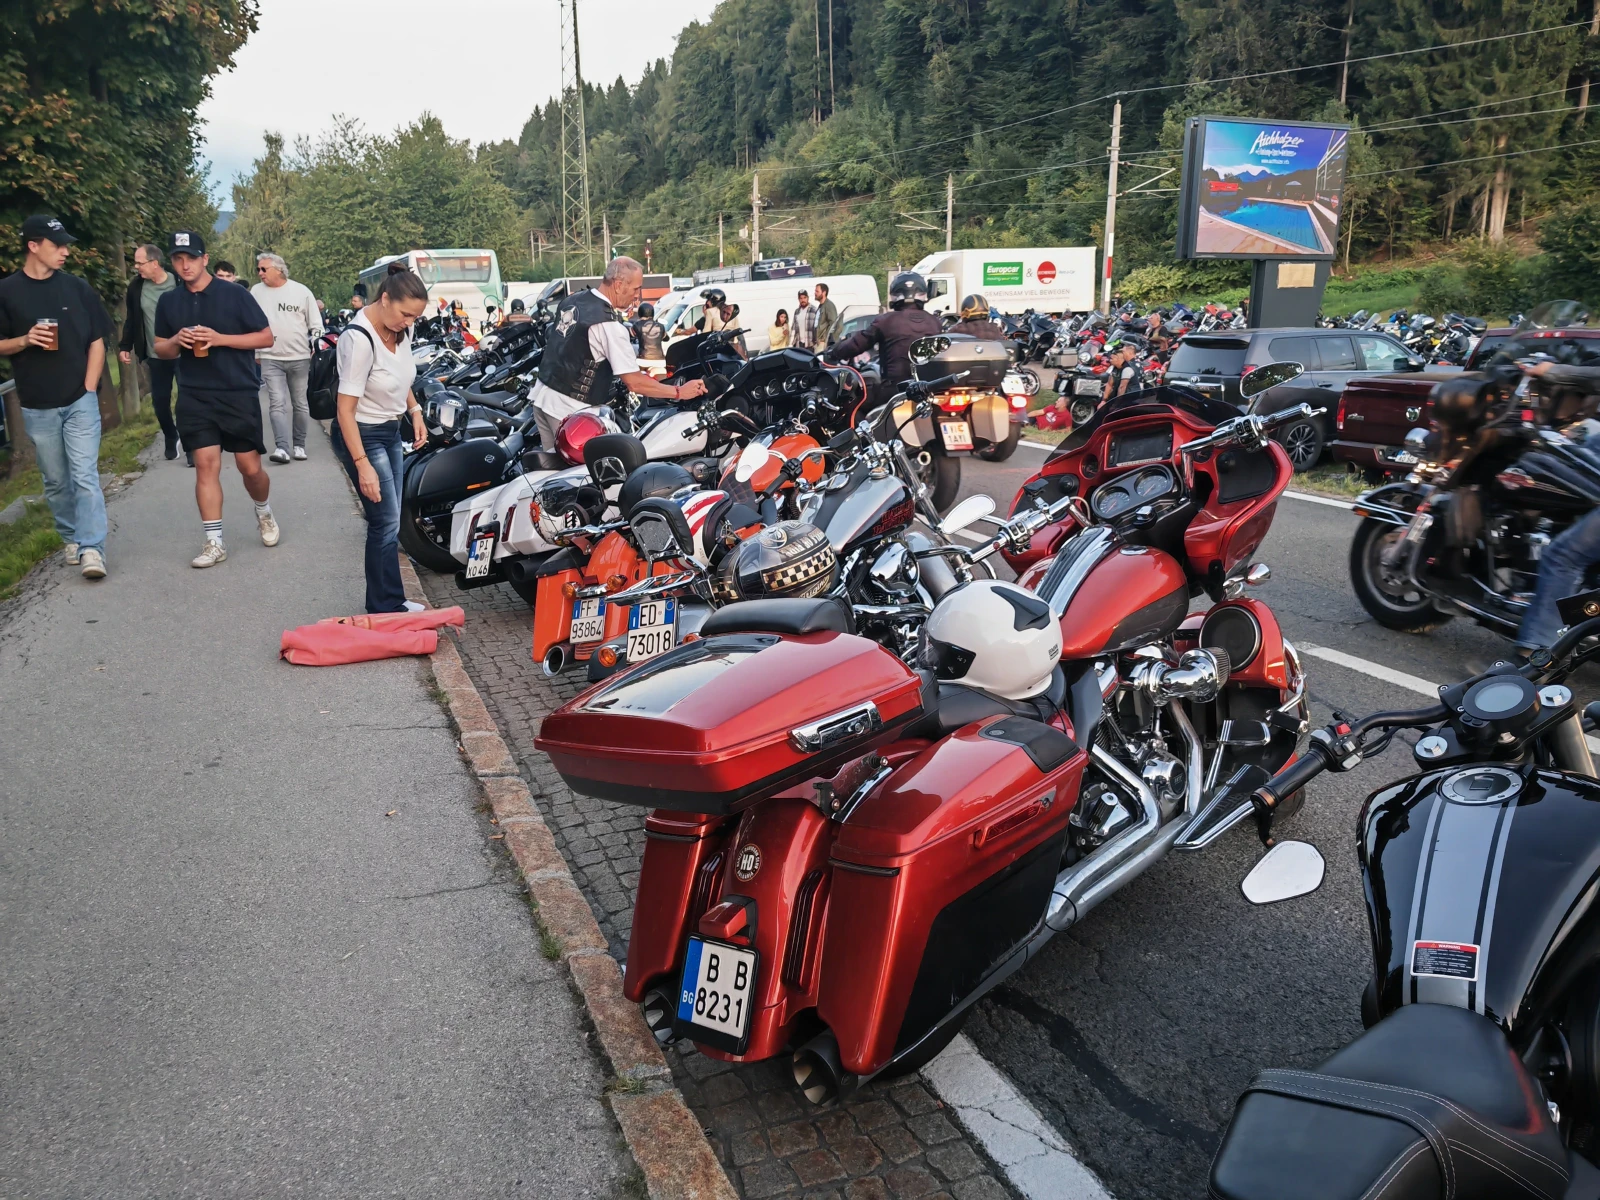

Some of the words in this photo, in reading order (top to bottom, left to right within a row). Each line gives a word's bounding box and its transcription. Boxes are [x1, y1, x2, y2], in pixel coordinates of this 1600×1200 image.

[987, 265, 1020, 275] Europcar
[278, 303, 300, 312] New
[580, 600, 593, 617] FF
[640, 604, 657, 627] ED
[572, 619, 602, 640] 93864
[629, 630, 671, 658] 73018
[740, 854, 755, 871] HD
[706, 953, 720, 983] B
[734, 960, 748, 991] B
[682, 990, 694, 1004] BG
[695, 986, 743, 1029] 8231
